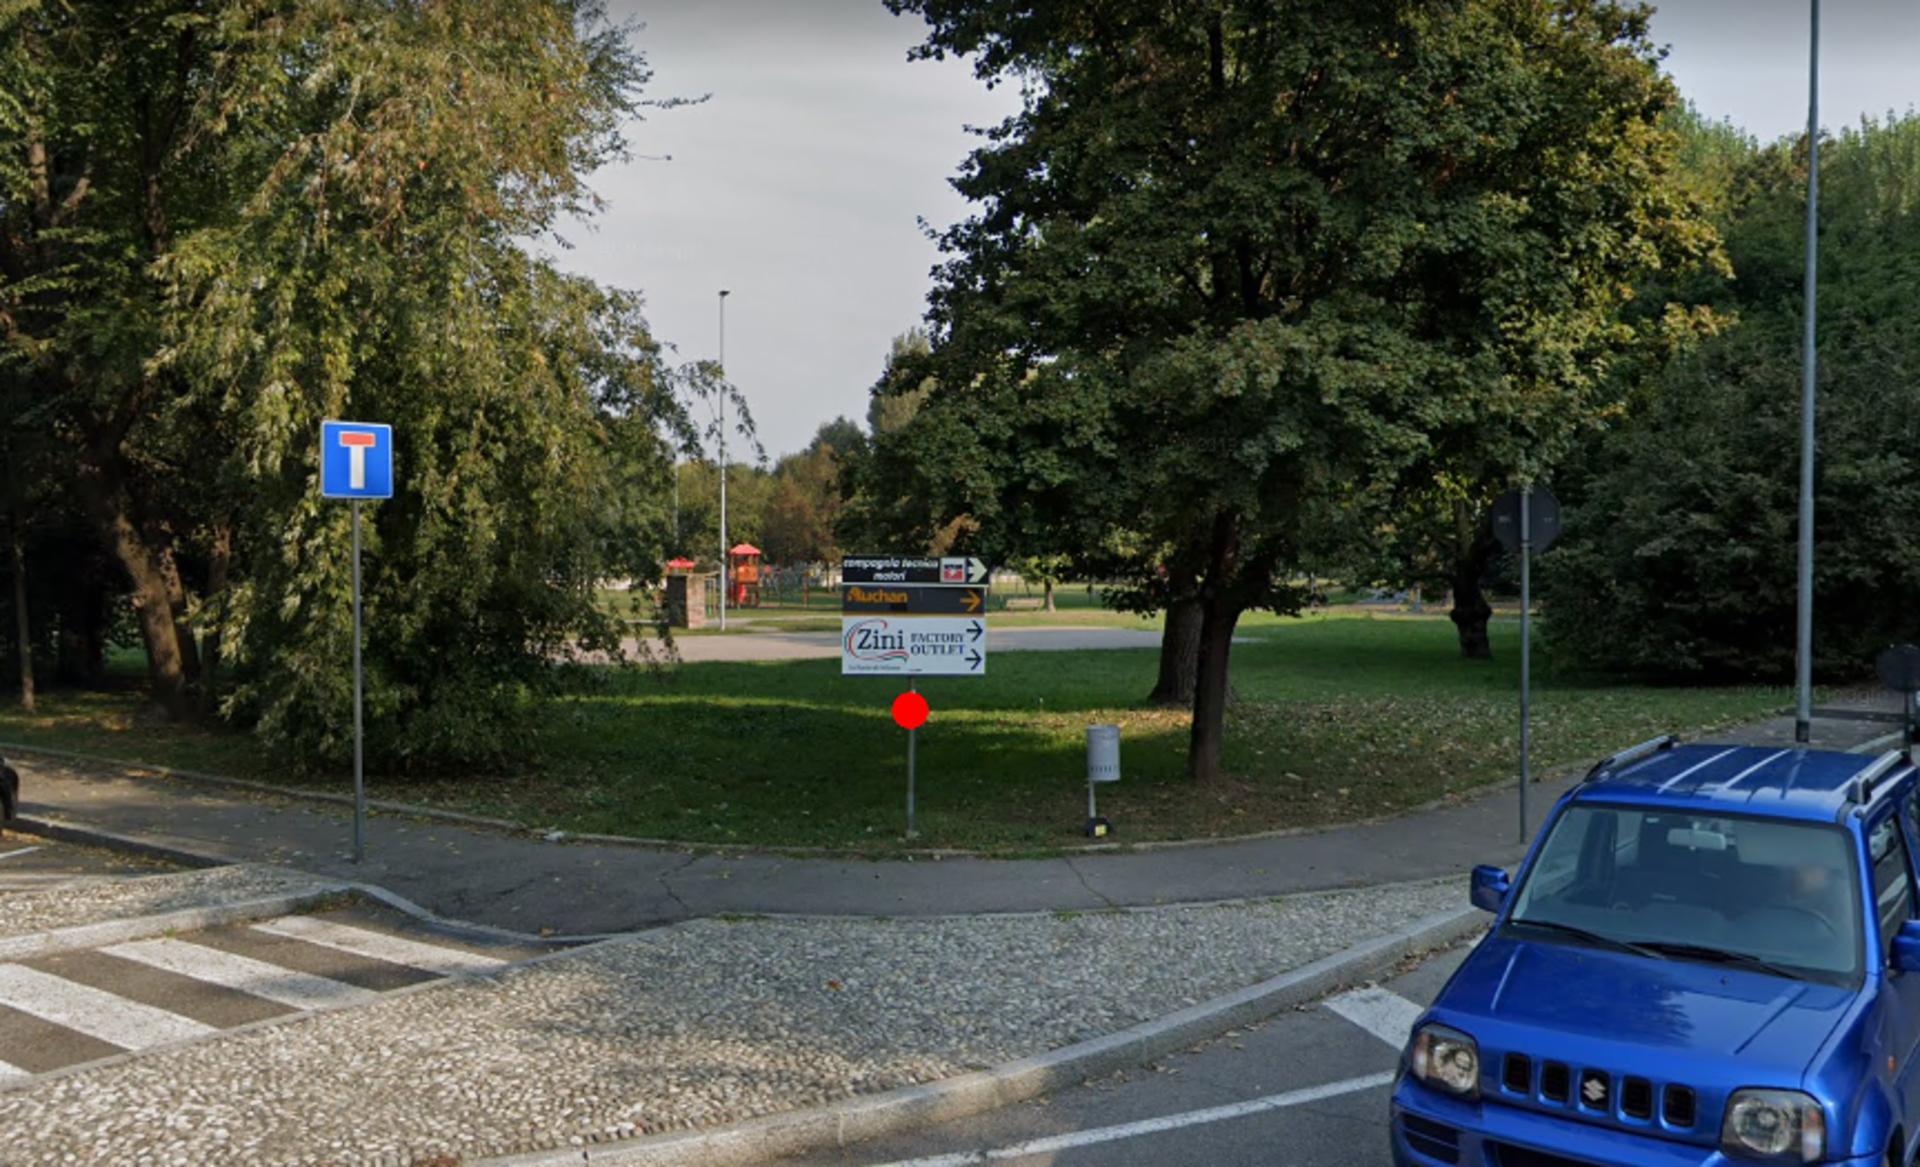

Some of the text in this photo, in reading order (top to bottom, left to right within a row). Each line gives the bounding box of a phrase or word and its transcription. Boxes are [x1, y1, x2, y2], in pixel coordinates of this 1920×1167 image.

[847, 586, 908, 603] Auchan
[857, 628, 904, 650] Zini
[910, 633, 964, 643] FACTORY
[910, 644, 965, 656] OUTLET
